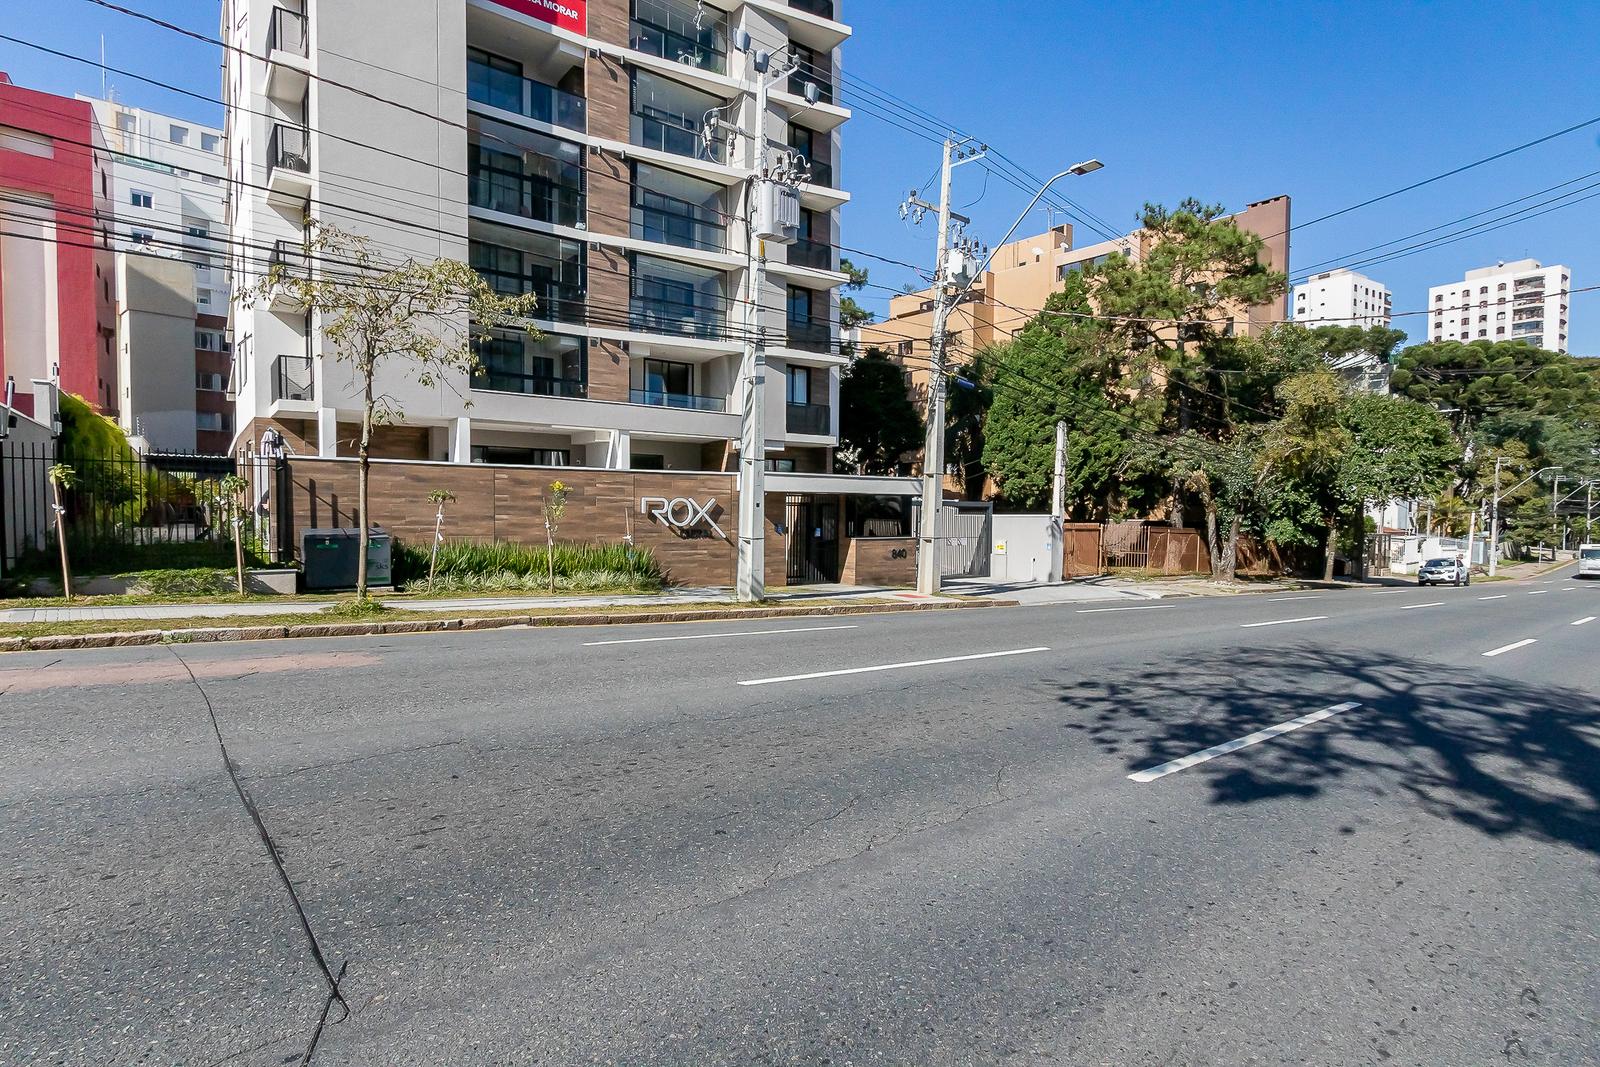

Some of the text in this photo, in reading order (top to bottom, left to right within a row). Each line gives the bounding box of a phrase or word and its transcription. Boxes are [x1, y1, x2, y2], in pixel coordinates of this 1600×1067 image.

[543, 0, 578, 20] MORAR
[641, 497, 727, 539] ROX
[891, 548, 907, 560] 840
